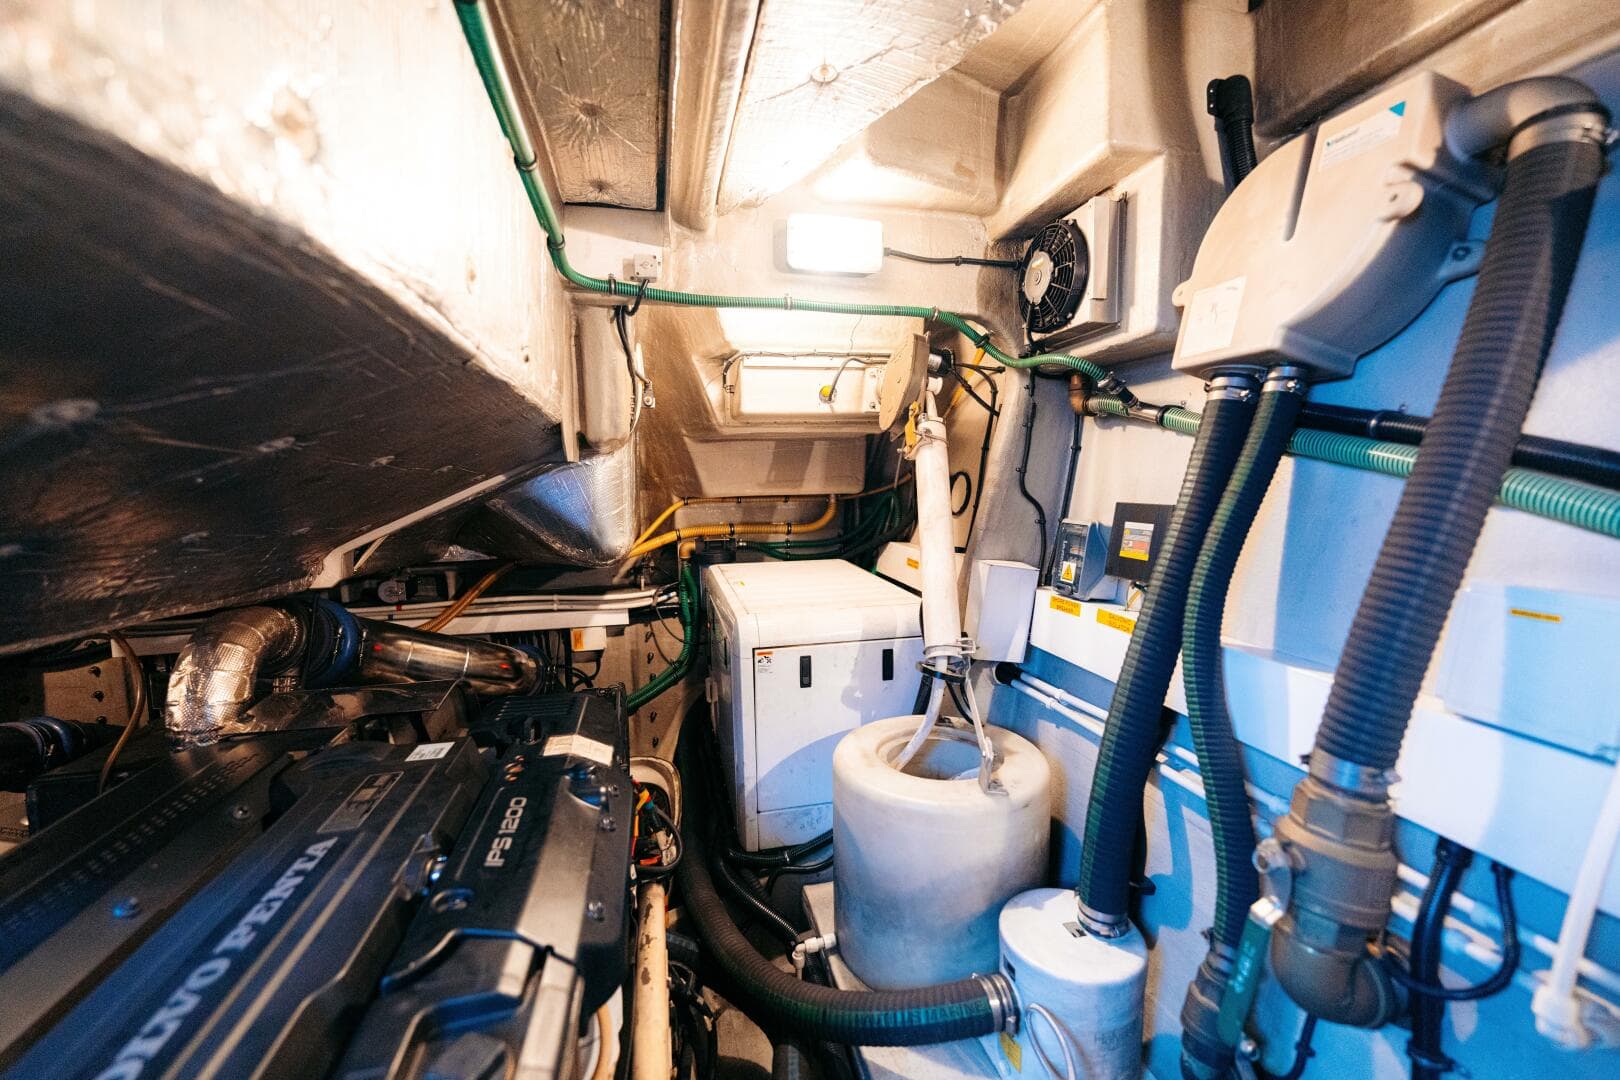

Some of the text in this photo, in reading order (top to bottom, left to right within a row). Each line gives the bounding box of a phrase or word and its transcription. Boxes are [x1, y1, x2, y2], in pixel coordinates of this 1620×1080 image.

[483, 797, 528, 867] IPS 1200
[212, 836, 338, 955] PENTA
